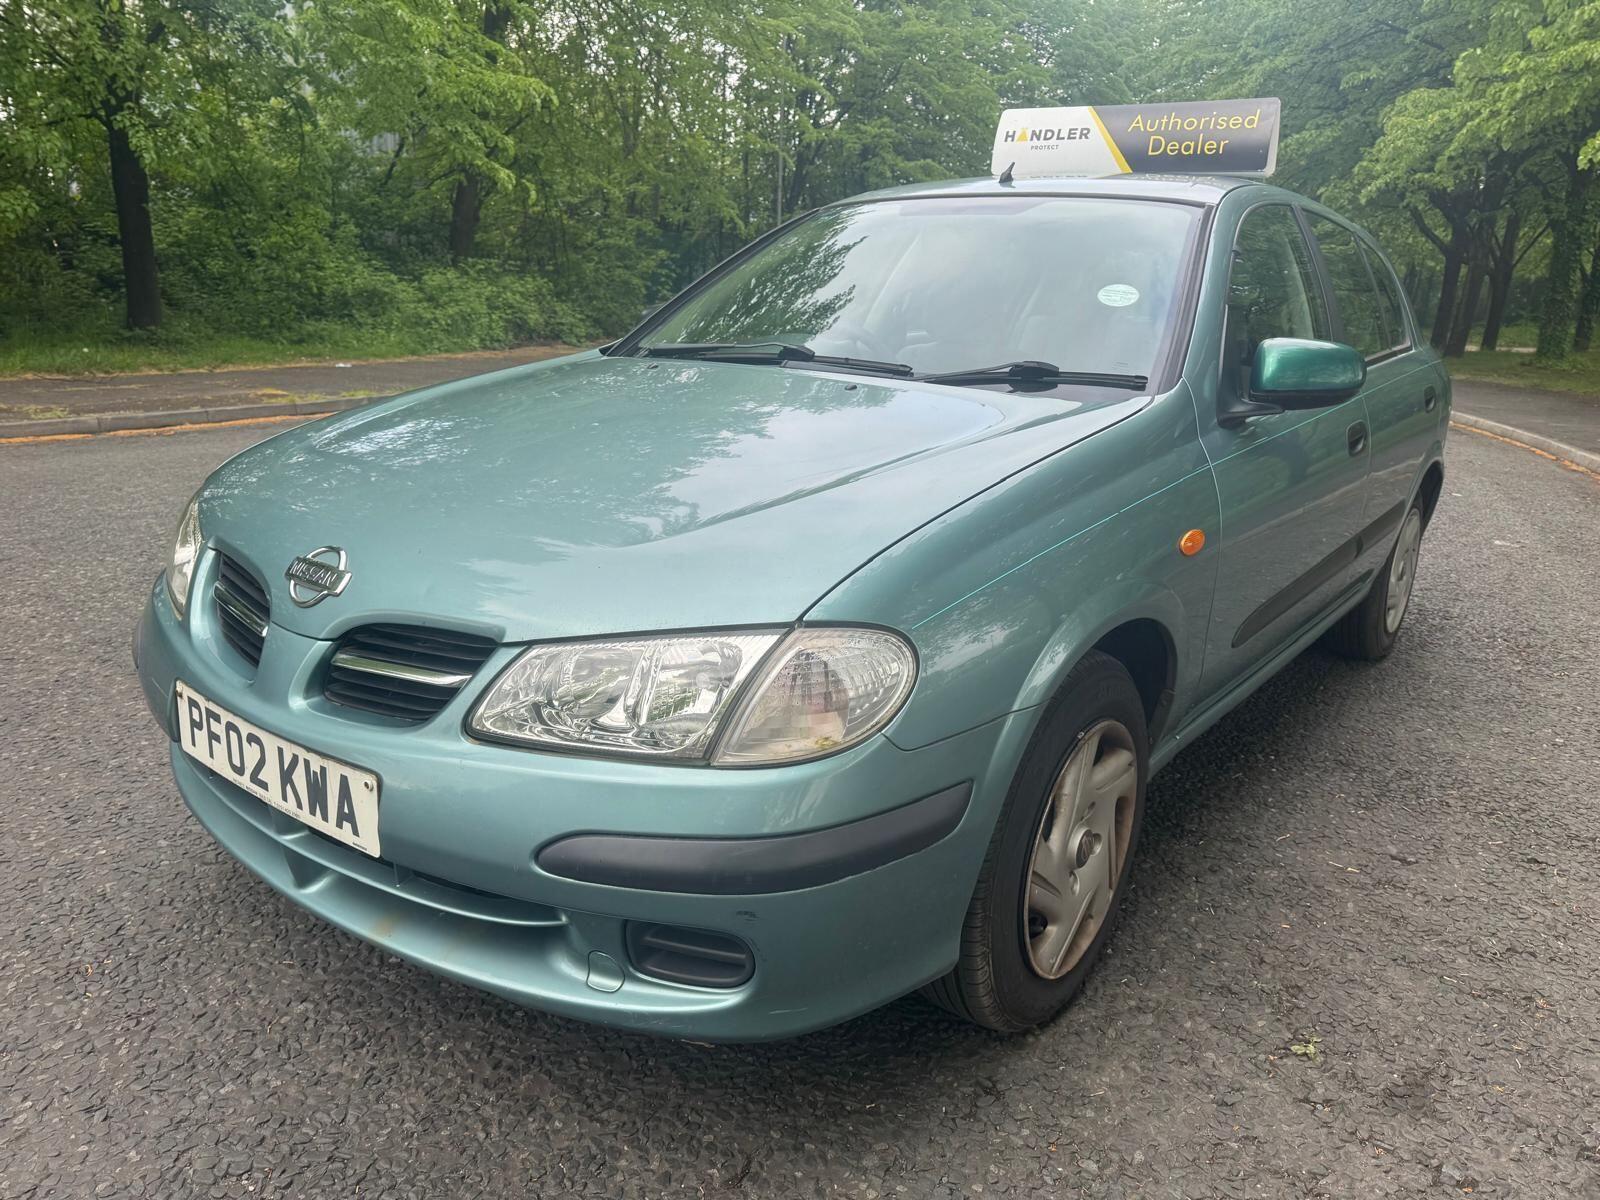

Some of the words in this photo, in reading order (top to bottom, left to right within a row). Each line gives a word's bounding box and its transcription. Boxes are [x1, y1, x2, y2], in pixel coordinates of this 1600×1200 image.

[1127, 108, 1261, 133] Authorised
[1147, 133, 1229, 156] Dealer
[289, 560, 338, 587] NISSAN
[187, 695, 269, 792] PF02
[277, 745, 360, 838] KWA
